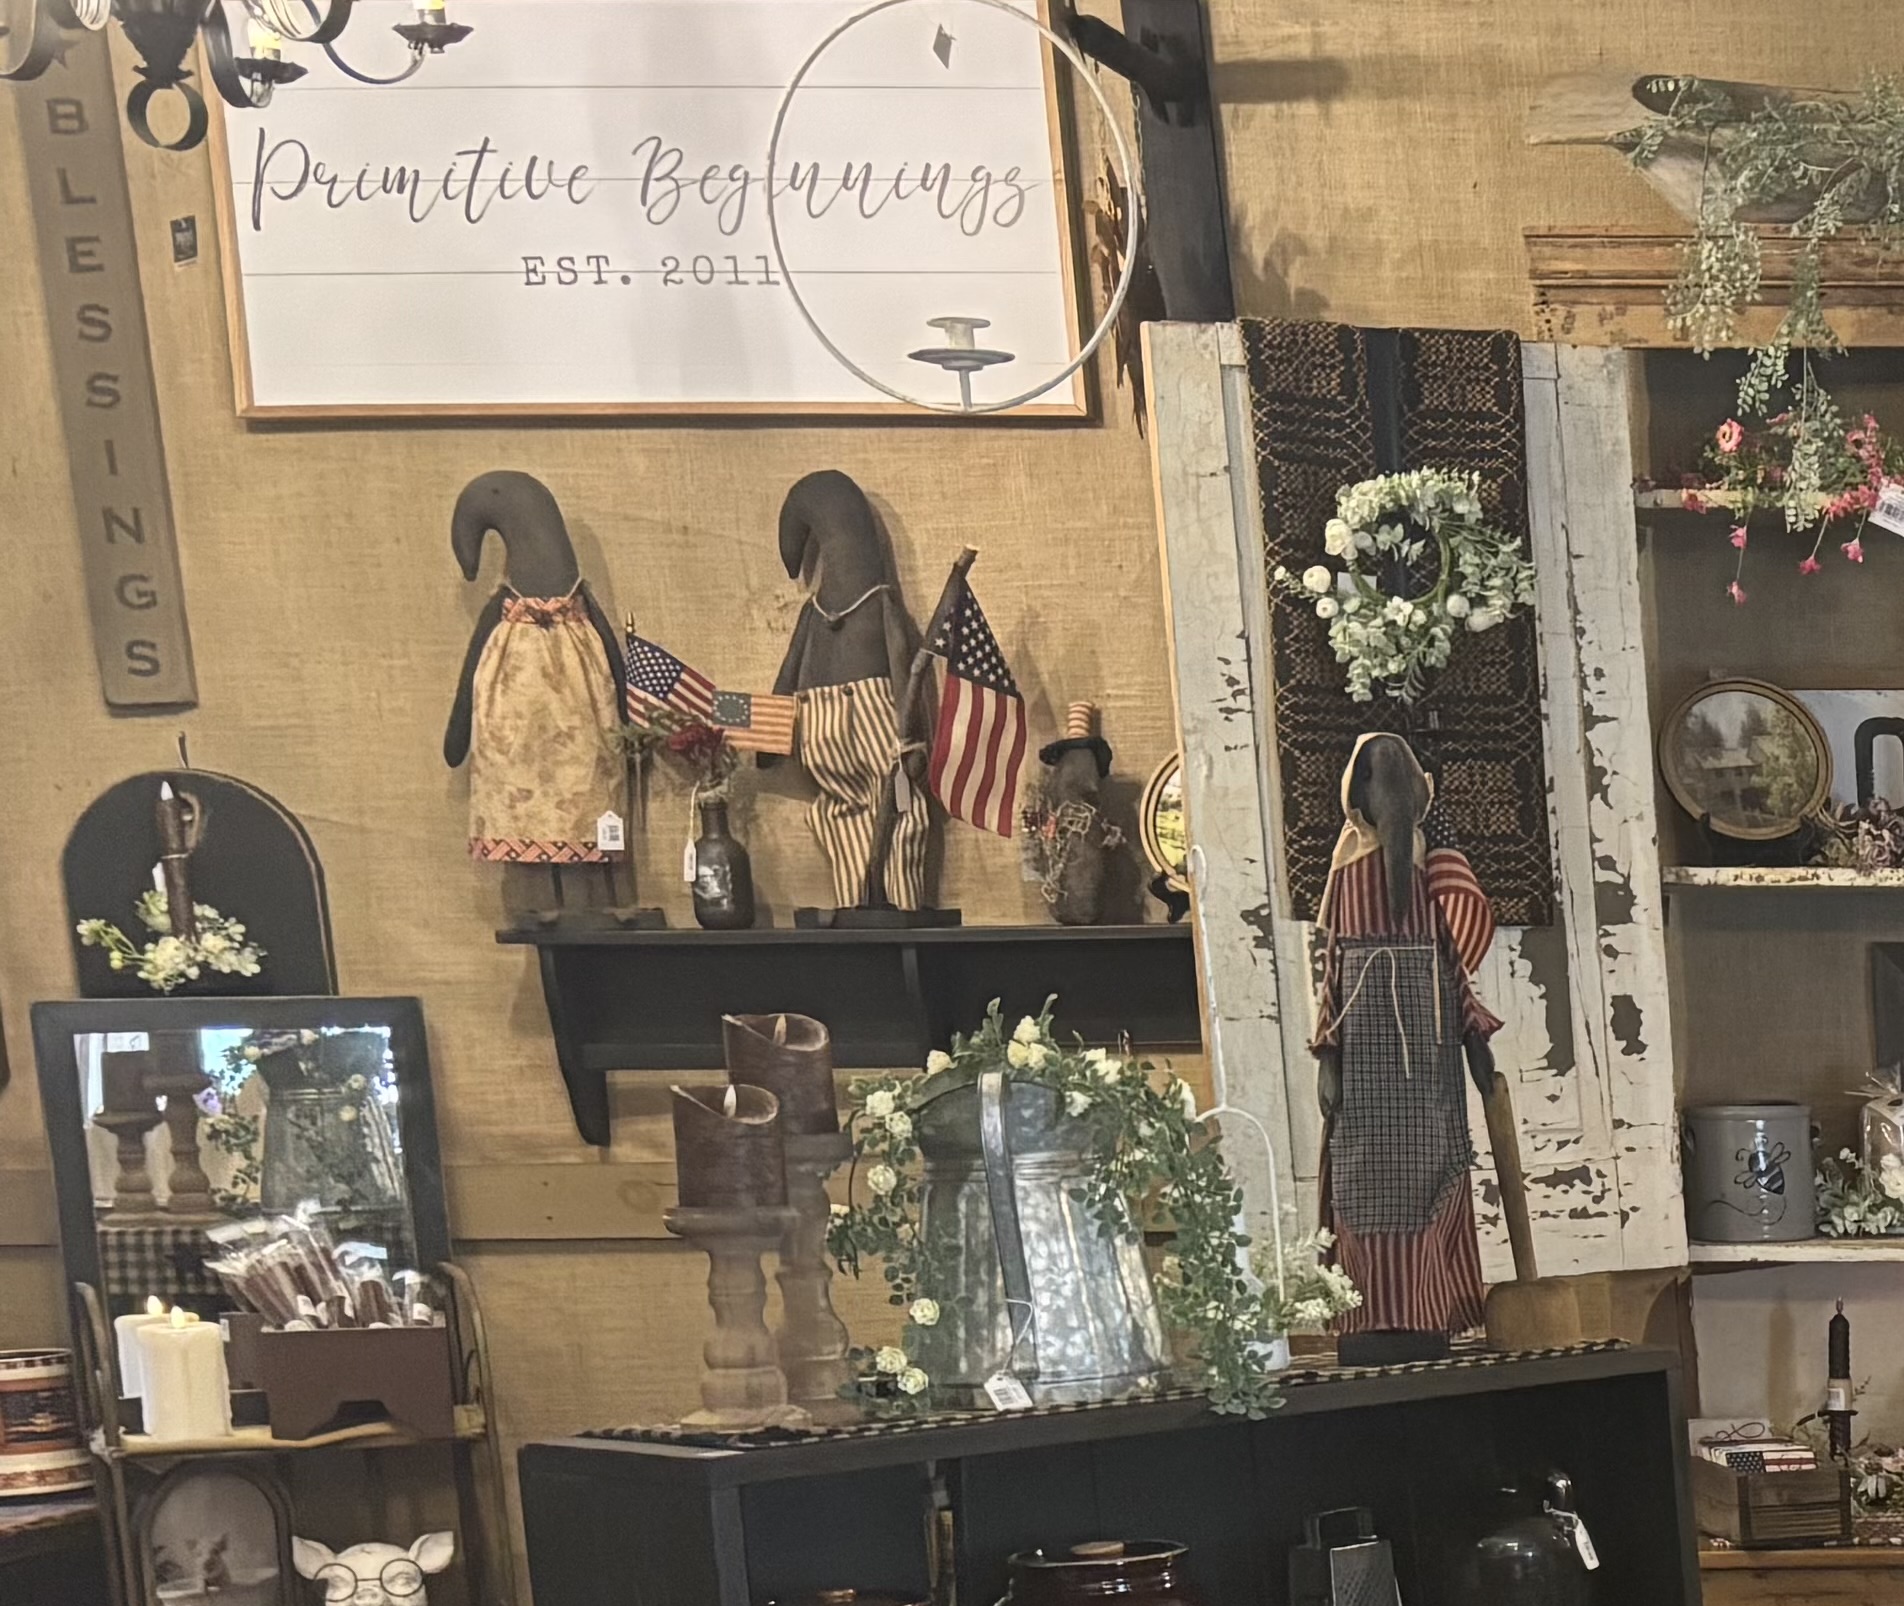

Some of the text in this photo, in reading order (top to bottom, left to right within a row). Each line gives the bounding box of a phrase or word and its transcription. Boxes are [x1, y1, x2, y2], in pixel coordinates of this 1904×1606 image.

[251, 127, 1041, 236] Primitive Begnnings
[521, 255, 781, 286] EST. 2011
[46, 97, 161, 678] BLESSINGS
